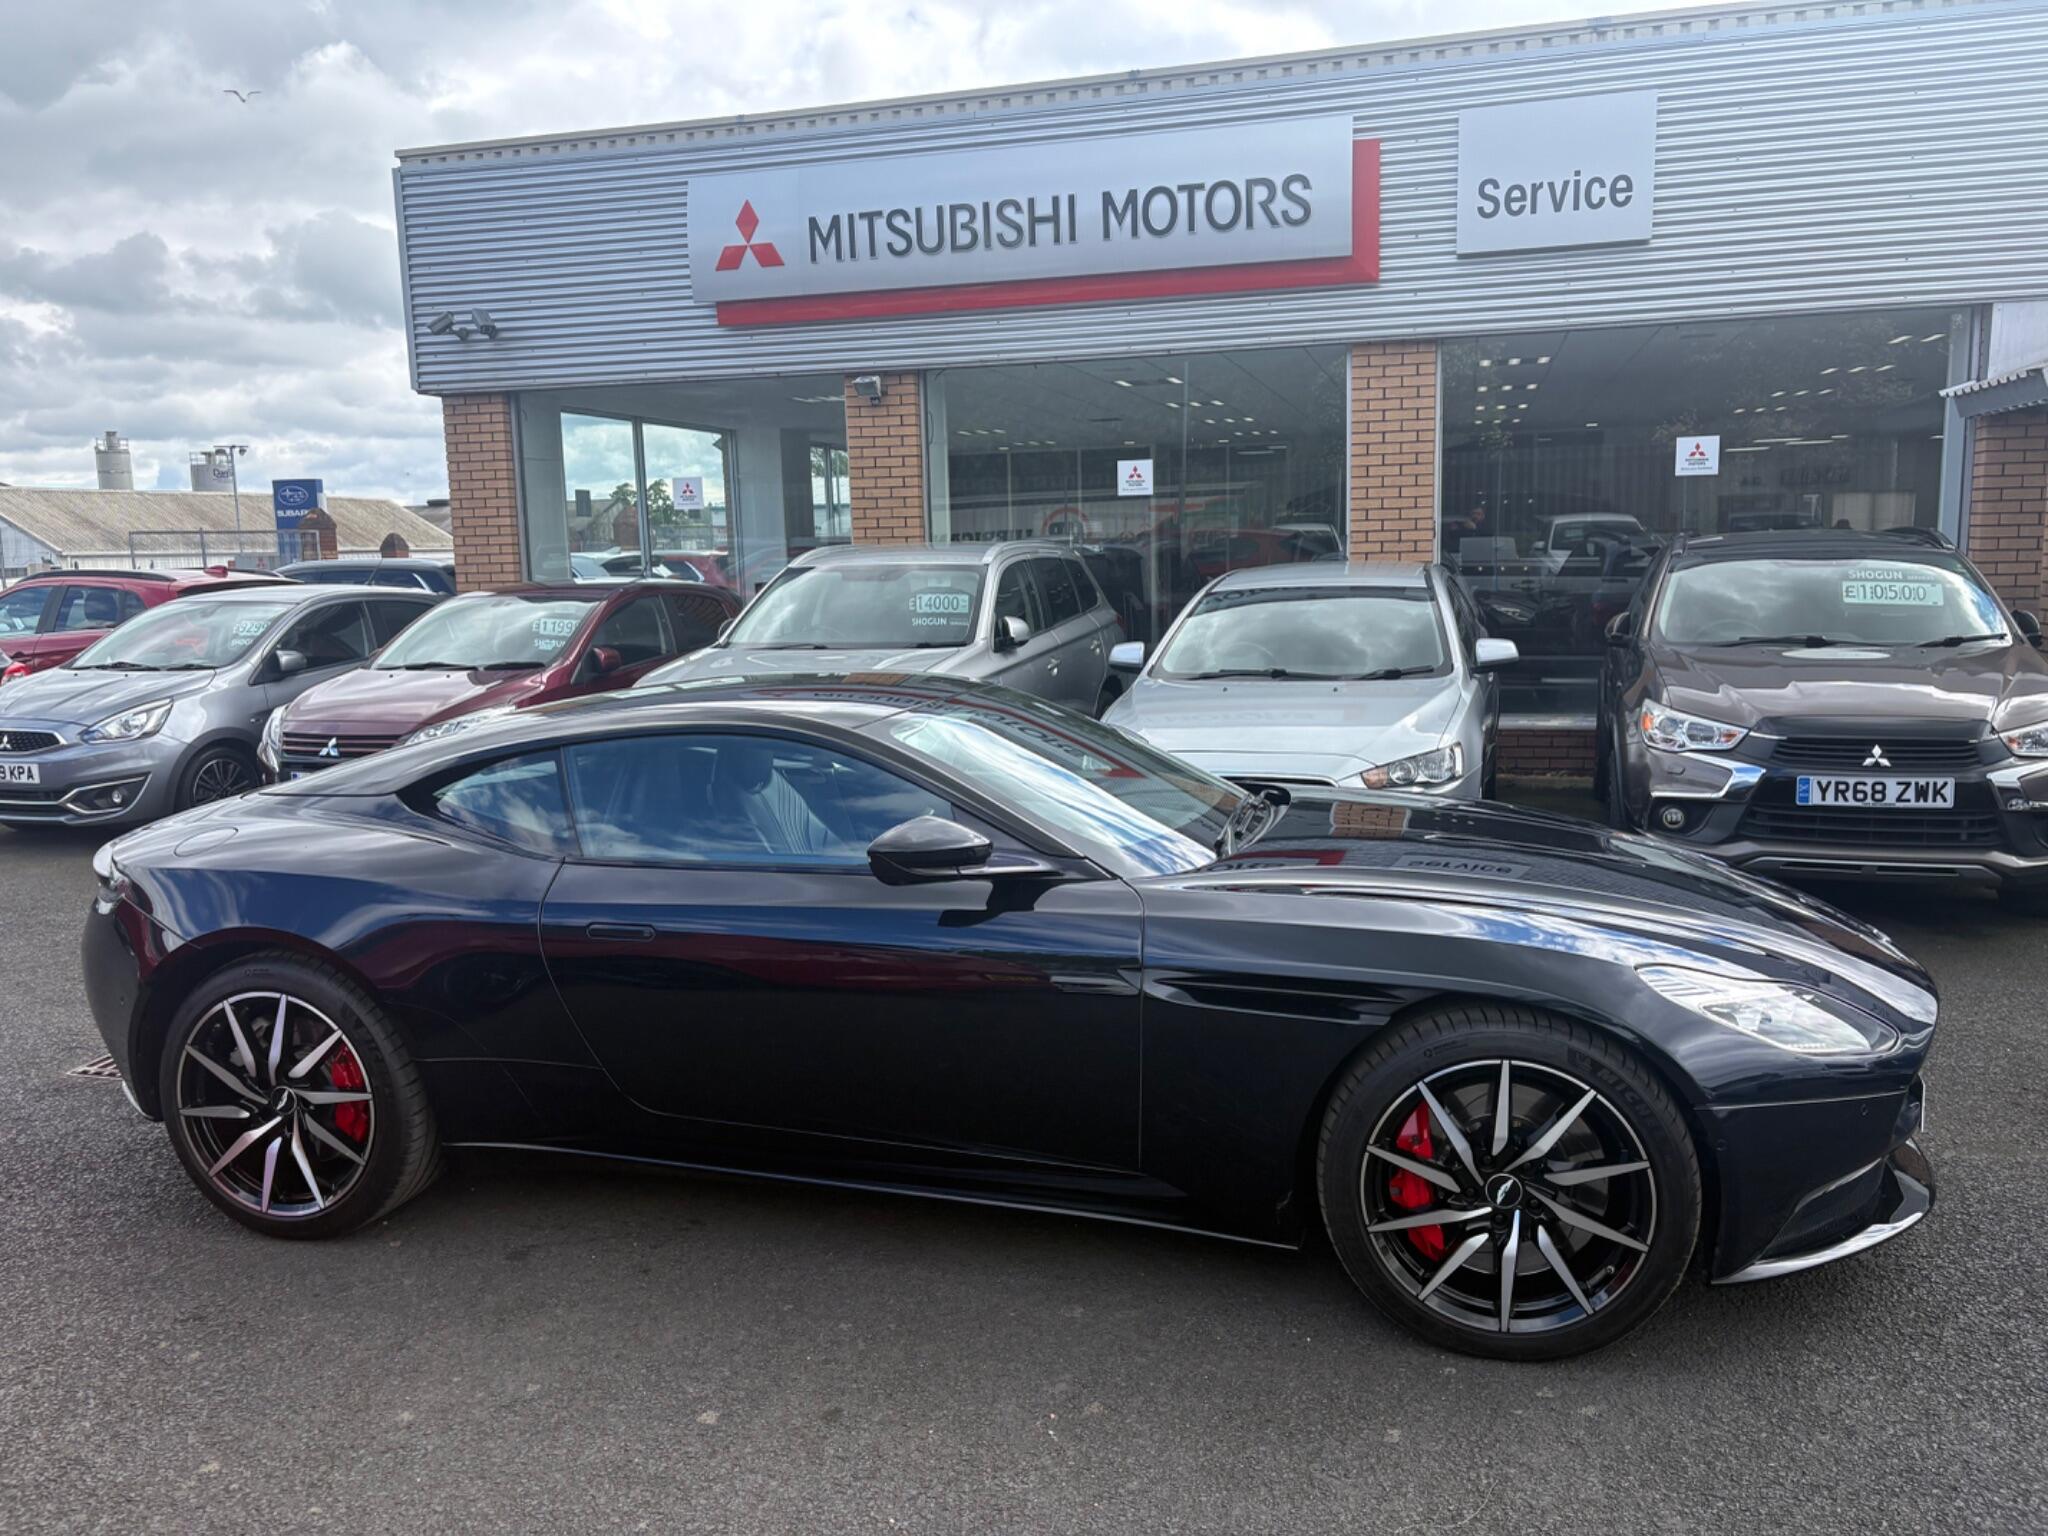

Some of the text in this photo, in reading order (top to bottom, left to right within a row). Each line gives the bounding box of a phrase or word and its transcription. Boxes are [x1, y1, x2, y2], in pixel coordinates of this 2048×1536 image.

[1477, 170, 1633, 219] Service
[808, 173, 1312, 264] MITSUBISHI MOTORS
[1848, 570, 1903, 580] SHOGUN
[911, 616, 947, 626] SHOGUN
[9, 765, 34, 781] KPA
[1817, 780, 1949, 804] YR68 ZWK
